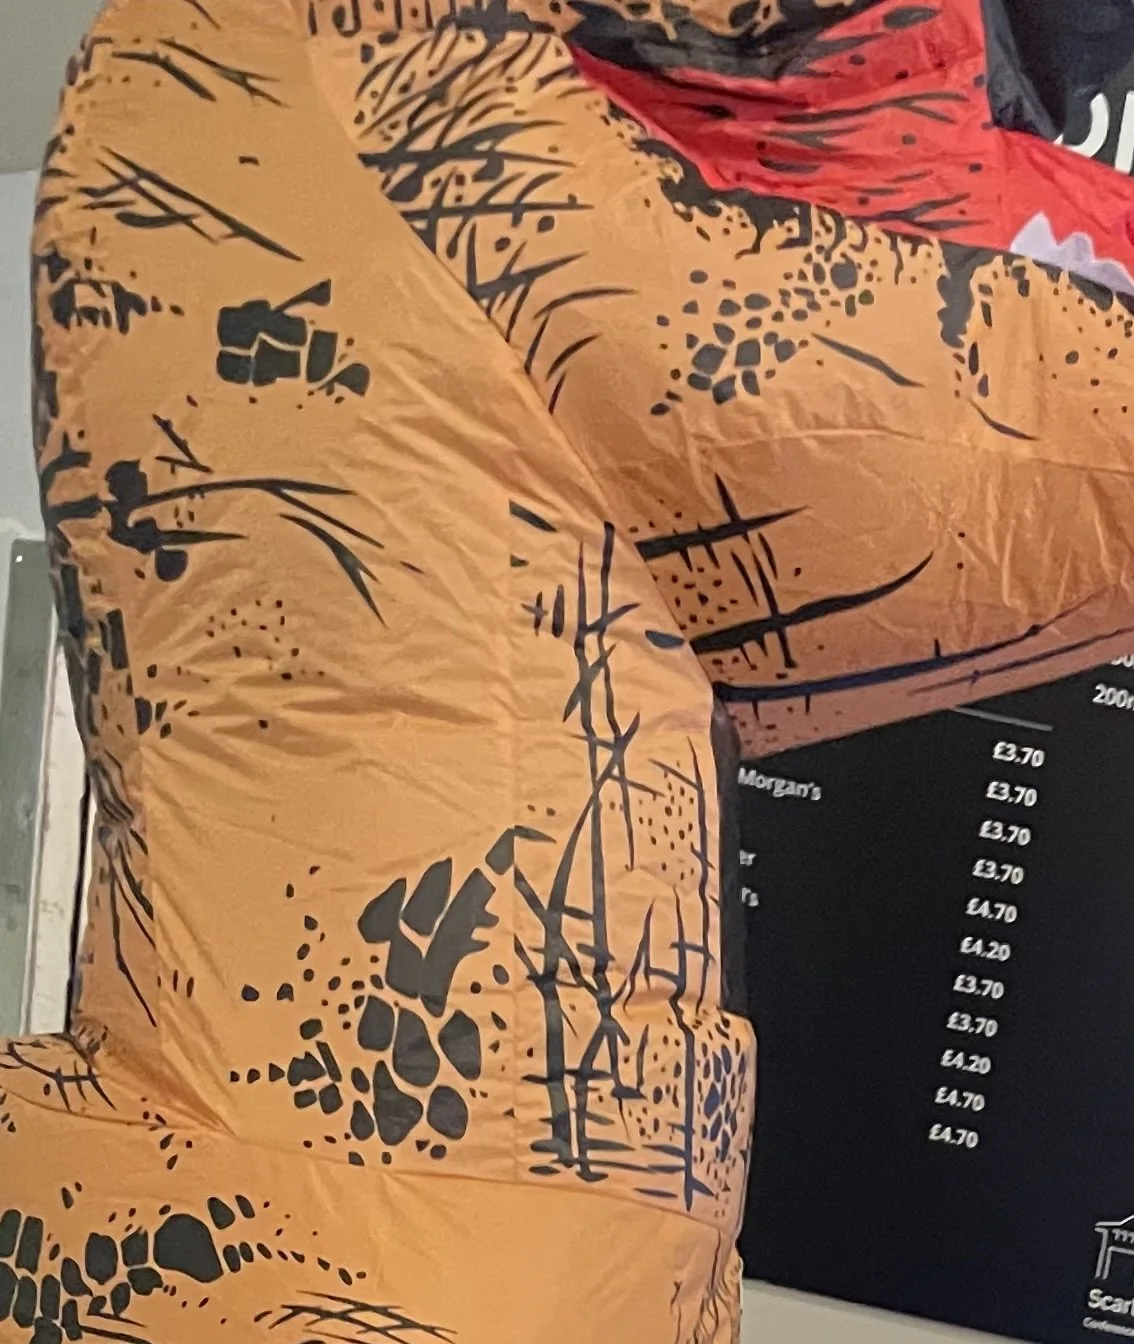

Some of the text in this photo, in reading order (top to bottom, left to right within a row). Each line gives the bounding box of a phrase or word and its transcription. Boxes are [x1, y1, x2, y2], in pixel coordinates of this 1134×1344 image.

[993, 741, 1046, 768] £3.70
[737, 767, 823, 801] Morgan's
[986, 780, 1039, 808] £3.70
[979, 819, 1032, 847] £3.70
[972, 859, 1025, 886] £3.70
[966, 897, 1018, 925] £4.70
[959, 936, 1012, 964] £4.20
[953, 974, 1005, 1001] £3.70
[946, 1012, 999, 1039] £3.70
[940, 1049, 992, 1076] £4.20
[934, 1086, 986, 1113] £4.70
[928, 1123, 980, 1150] £4.70
